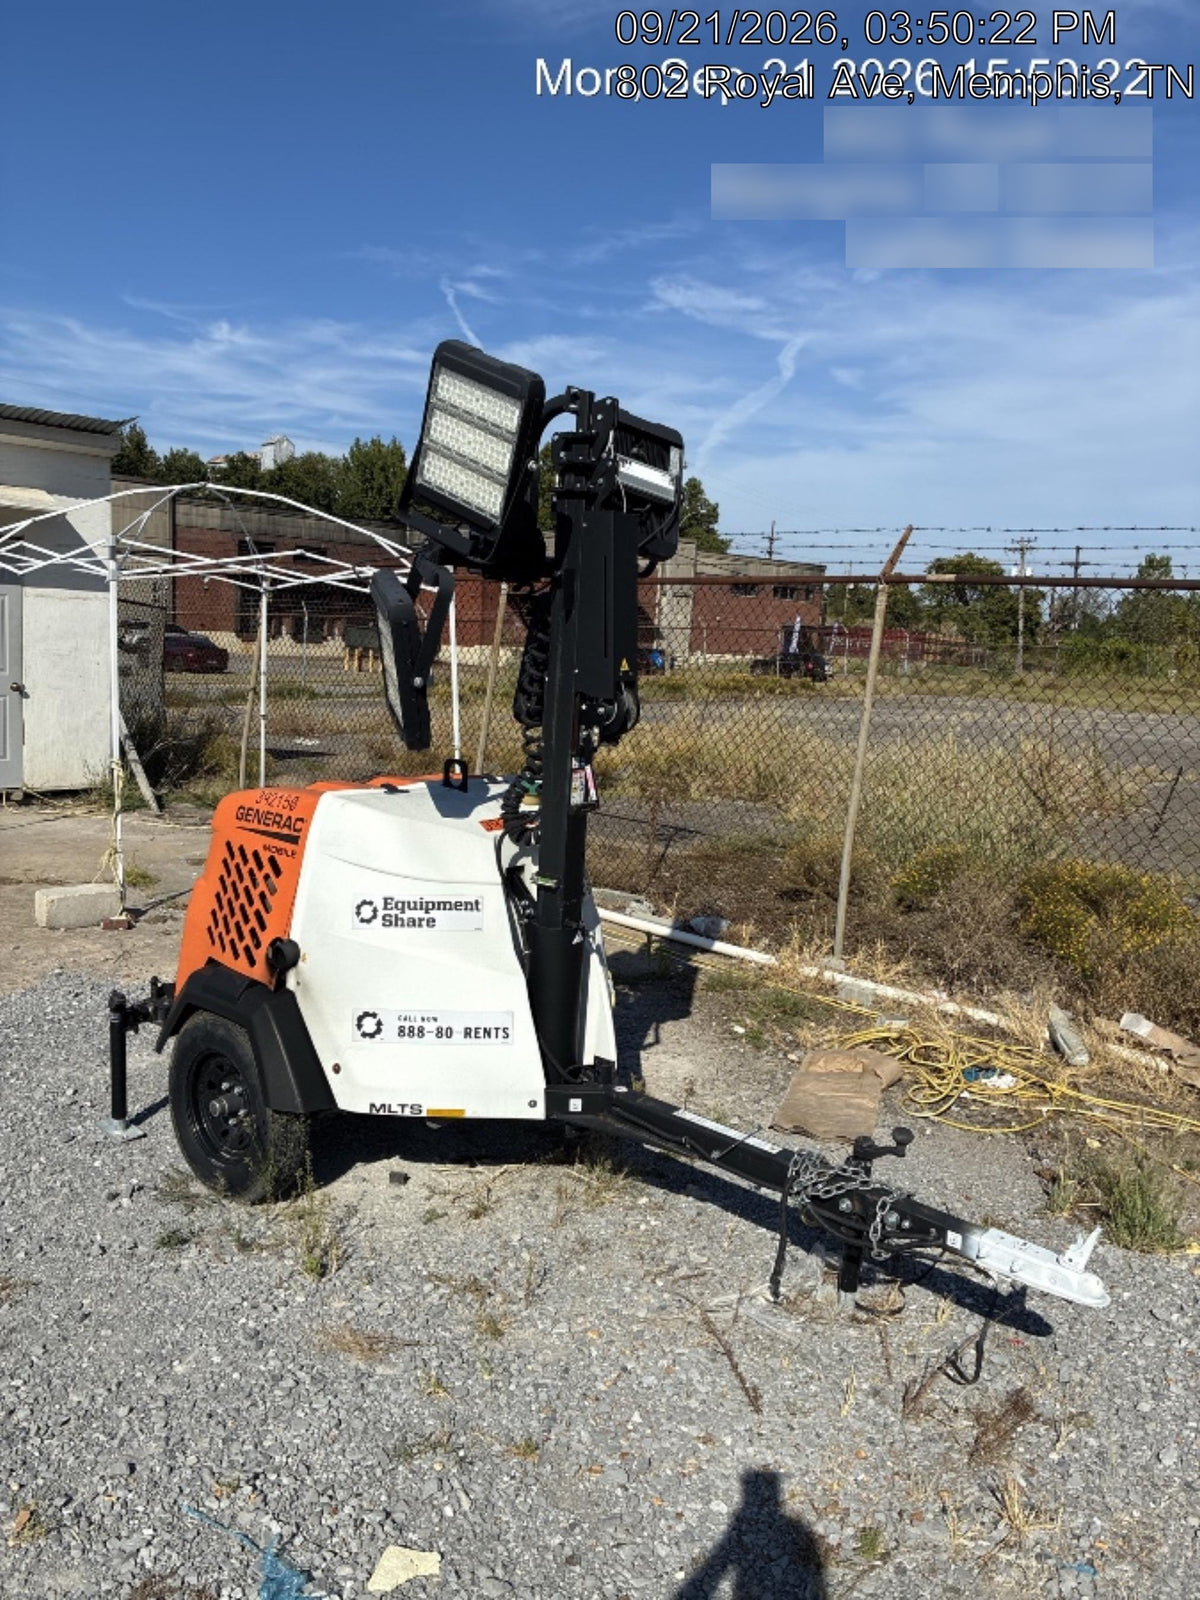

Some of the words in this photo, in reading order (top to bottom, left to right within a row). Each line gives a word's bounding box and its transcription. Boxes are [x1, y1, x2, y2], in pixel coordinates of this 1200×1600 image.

[235, 804, 305, 833] GENERAC
[381, 897, 482, 914] Equipment
[381, 913, 437, 929] Share
[369, 1102, 423, 1115] MLTS
